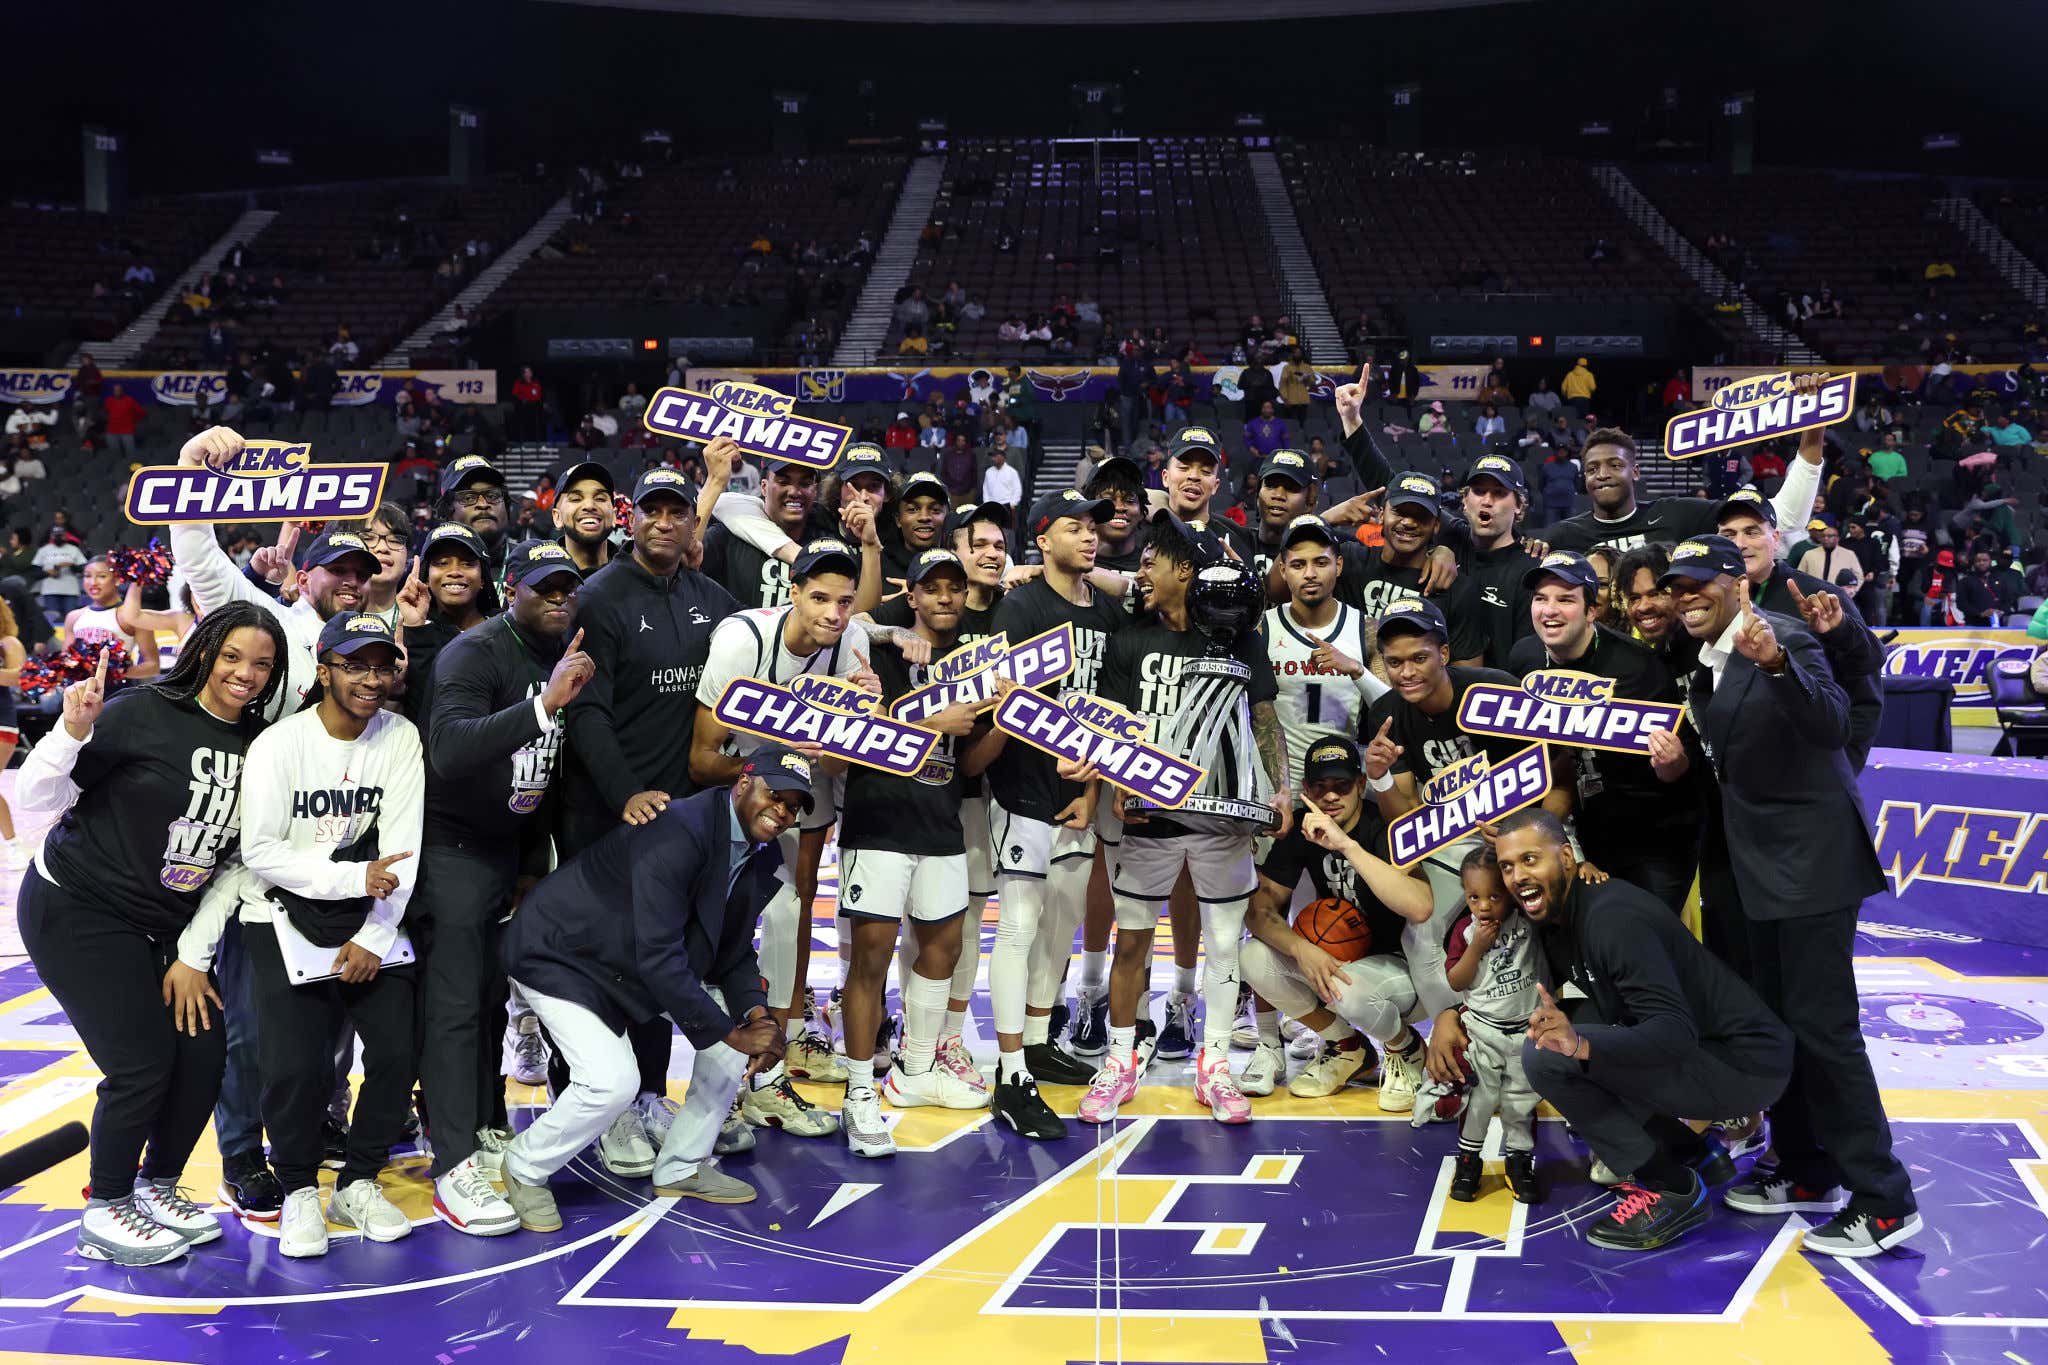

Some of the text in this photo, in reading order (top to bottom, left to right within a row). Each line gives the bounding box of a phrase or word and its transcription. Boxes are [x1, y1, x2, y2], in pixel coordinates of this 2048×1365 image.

[160, 375, 227, 392] MEAC
[459, 380, 481, 392] 113
[720, 385, 792, 416] MEAC
[1451, 376, 1476, 389] 111
[1721, 375, 1787, 410] MEAC
[653, 395, 839, 460] CHAMPS
[1672, 383, 1845, 452] CHAMPS
[223, 446, 306, 472] MEAC
[138, 473, 372, 514] CHAMPS
[940, 635, 1005, 680] MEAC
[1075, 627, 1107, 660] UT
[651, 664, 704, 685] HOWAR
[1531, 674, 1613, 700] MEAC
[798, 678, 878, 714] MEAC
[1305, 682, 1322, 723] 1
[722, 686, 925, 766] CHAMPS
[1072, 697, 1146, 741] MEAC
[1465, 693, 1669, 744] CHAMPS
[1002, 695, 1190, 799] CHAMPS
[191, 747, 243, 789] CU
[1428, 755, 1485, 803] MEAC
[1395, 754, 1542, 859] CHAMPS
[1874, 800, 2048, 896] MEA
